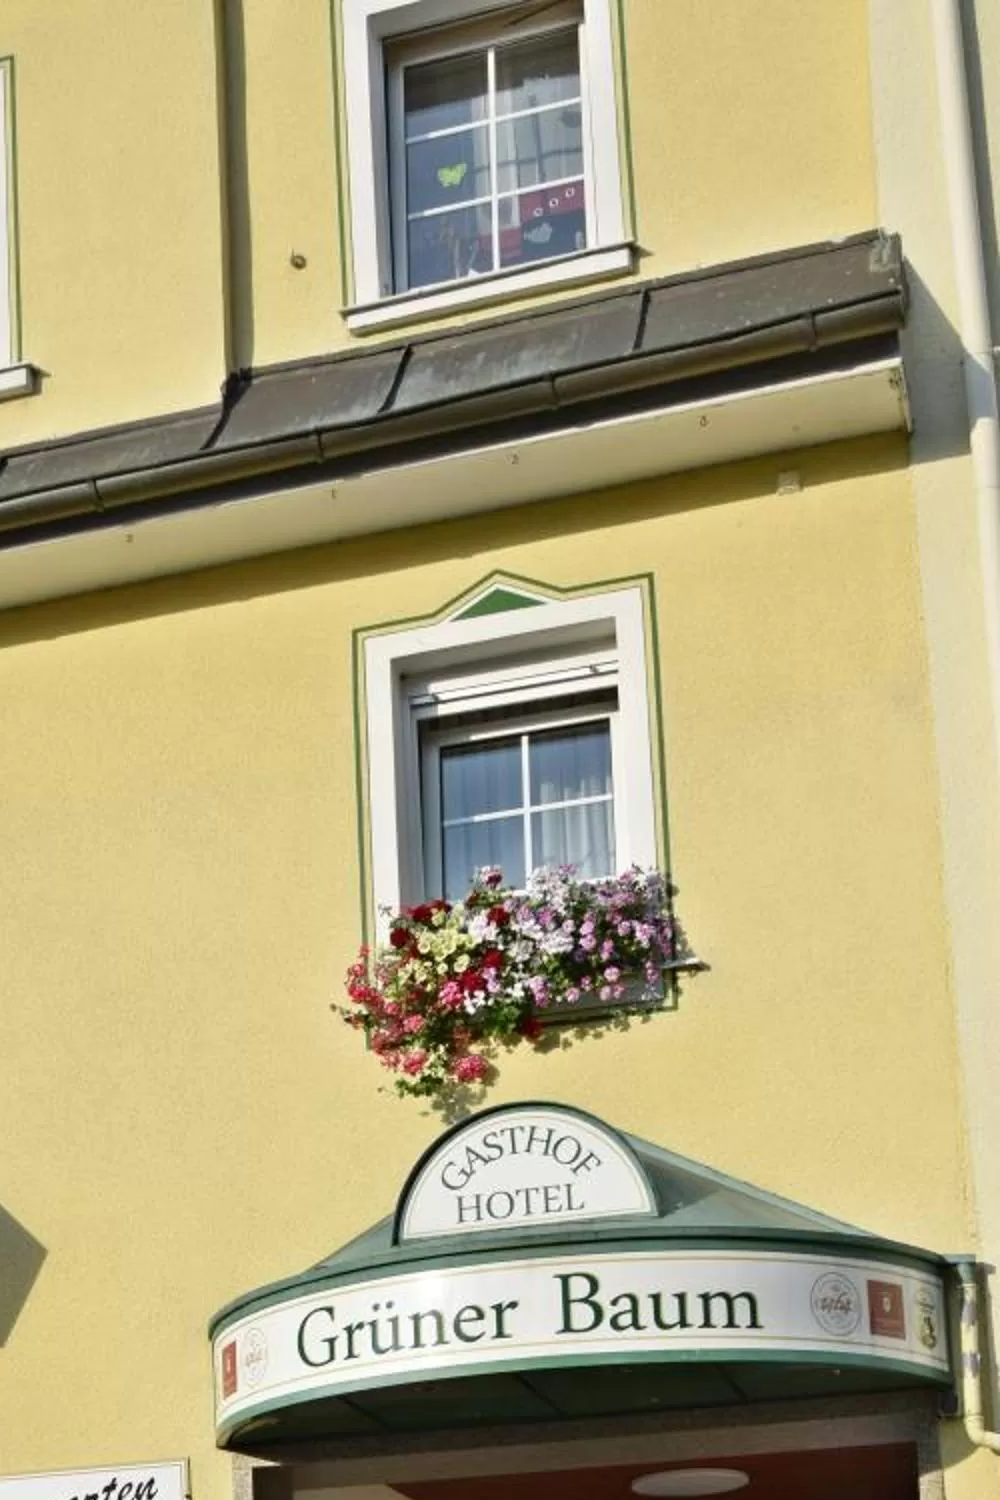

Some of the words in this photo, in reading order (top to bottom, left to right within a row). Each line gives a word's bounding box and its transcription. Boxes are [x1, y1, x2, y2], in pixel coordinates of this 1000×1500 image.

[441, 1125, 602, 1191] GASTHOF
[456, 1184, 585, 1223] HOTEL
[297, 1300, 519, 1368] Grüner
[552, 1272, 765, 1335] Baum
